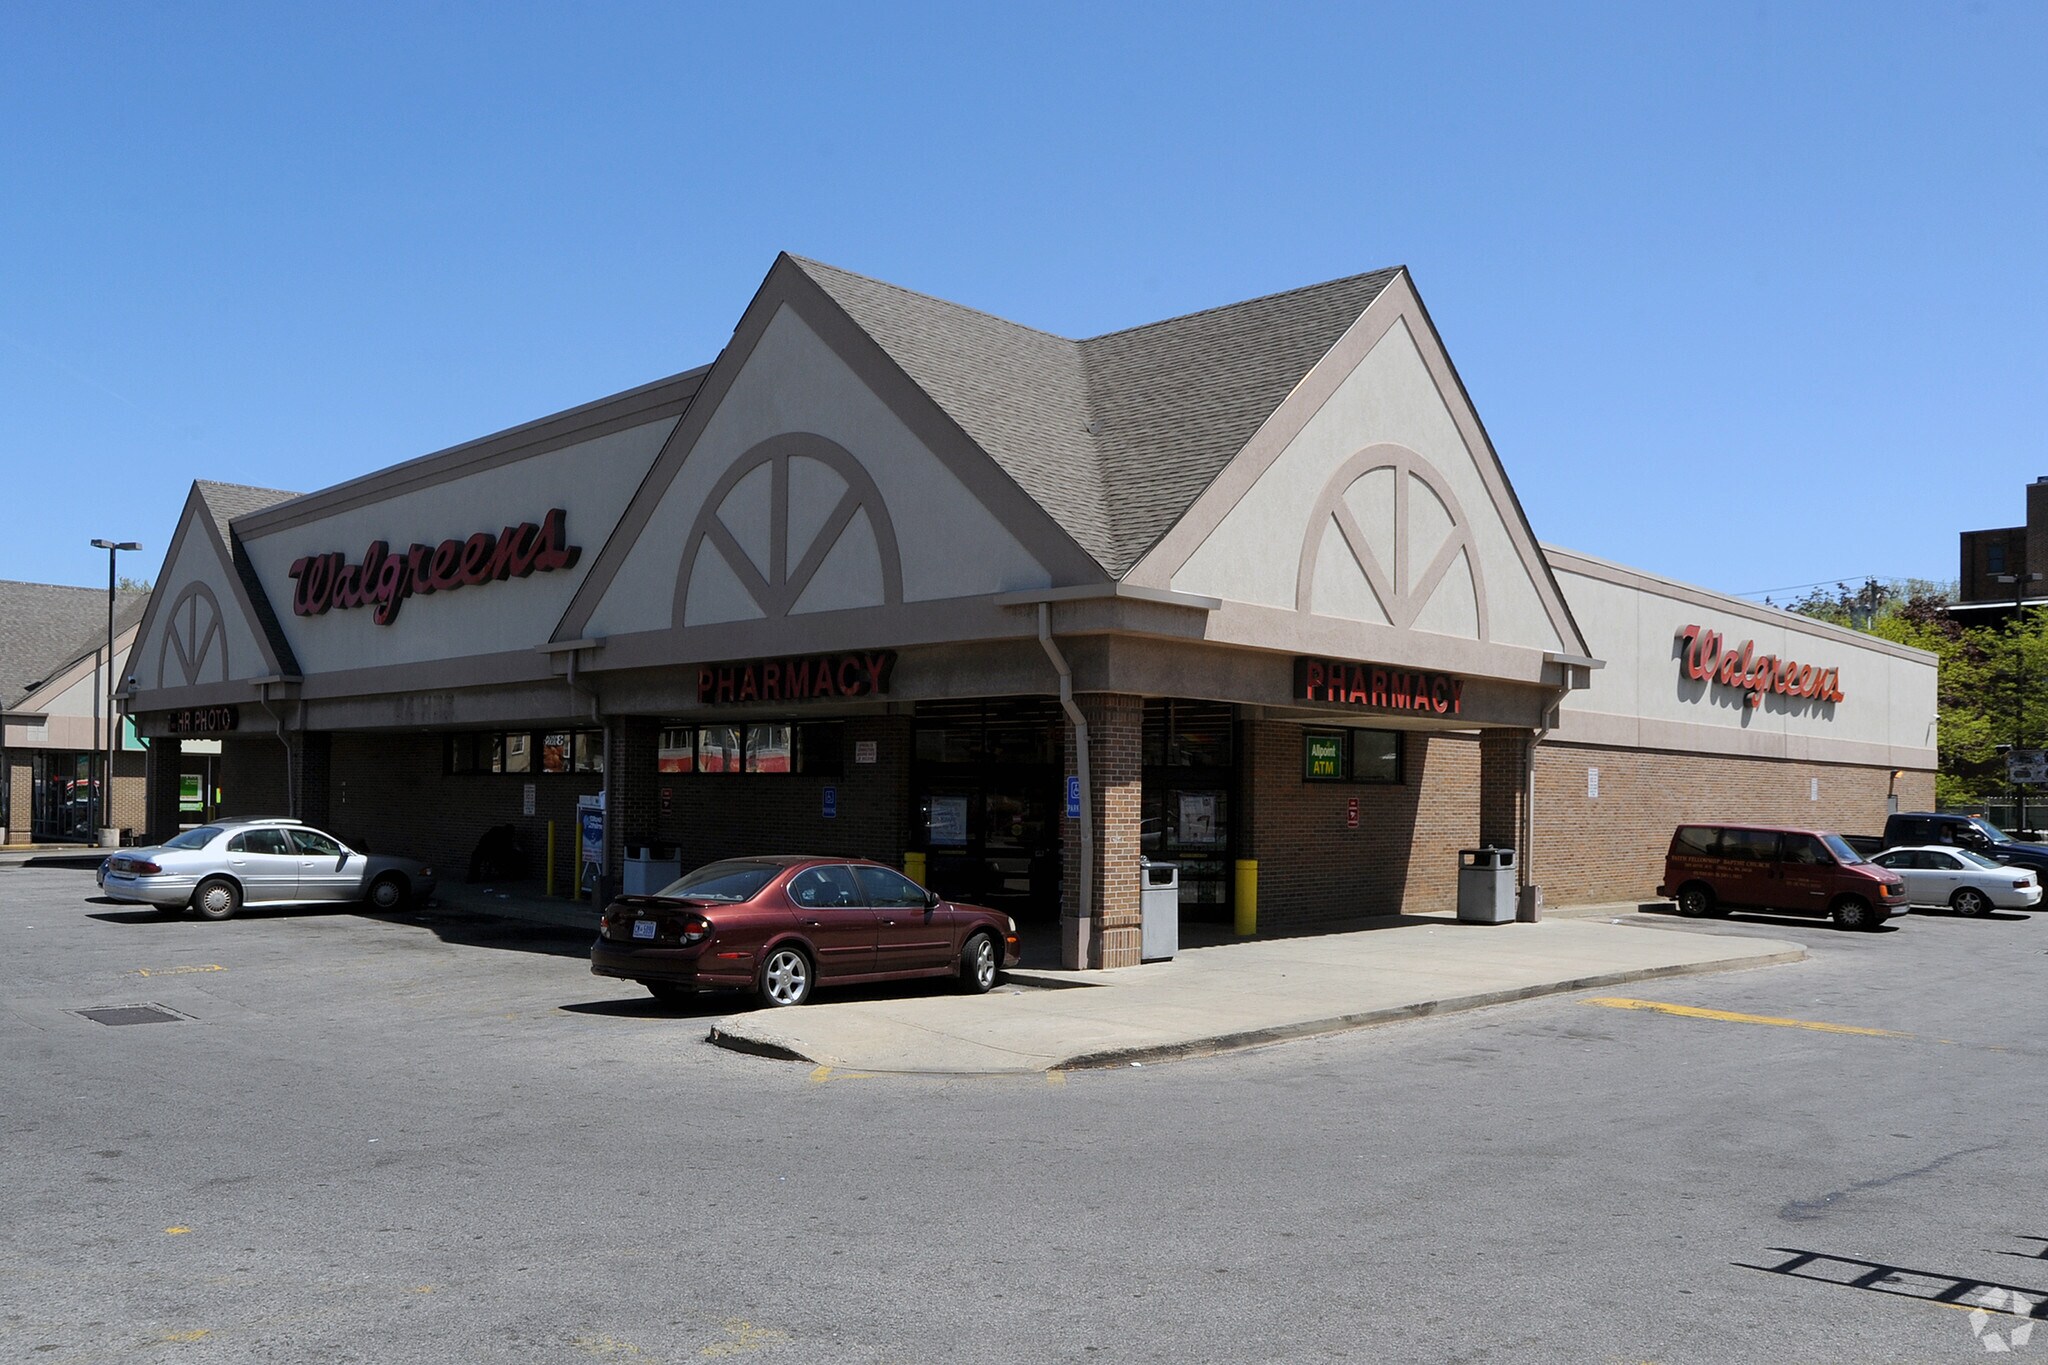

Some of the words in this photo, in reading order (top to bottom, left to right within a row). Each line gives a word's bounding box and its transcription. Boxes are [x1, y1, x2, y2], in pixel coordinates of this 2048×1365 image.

[289, 508, 580, 625] Walgreens
[697, 655, 886, 703] PHARMACY
[1306, 661, 1465, 714] PHARMACY
[1678, 624, 1845, 708] Walgreens
[194, 707, 231, 731] PHOTO
[1313, 761, 1334, 775] ATM
